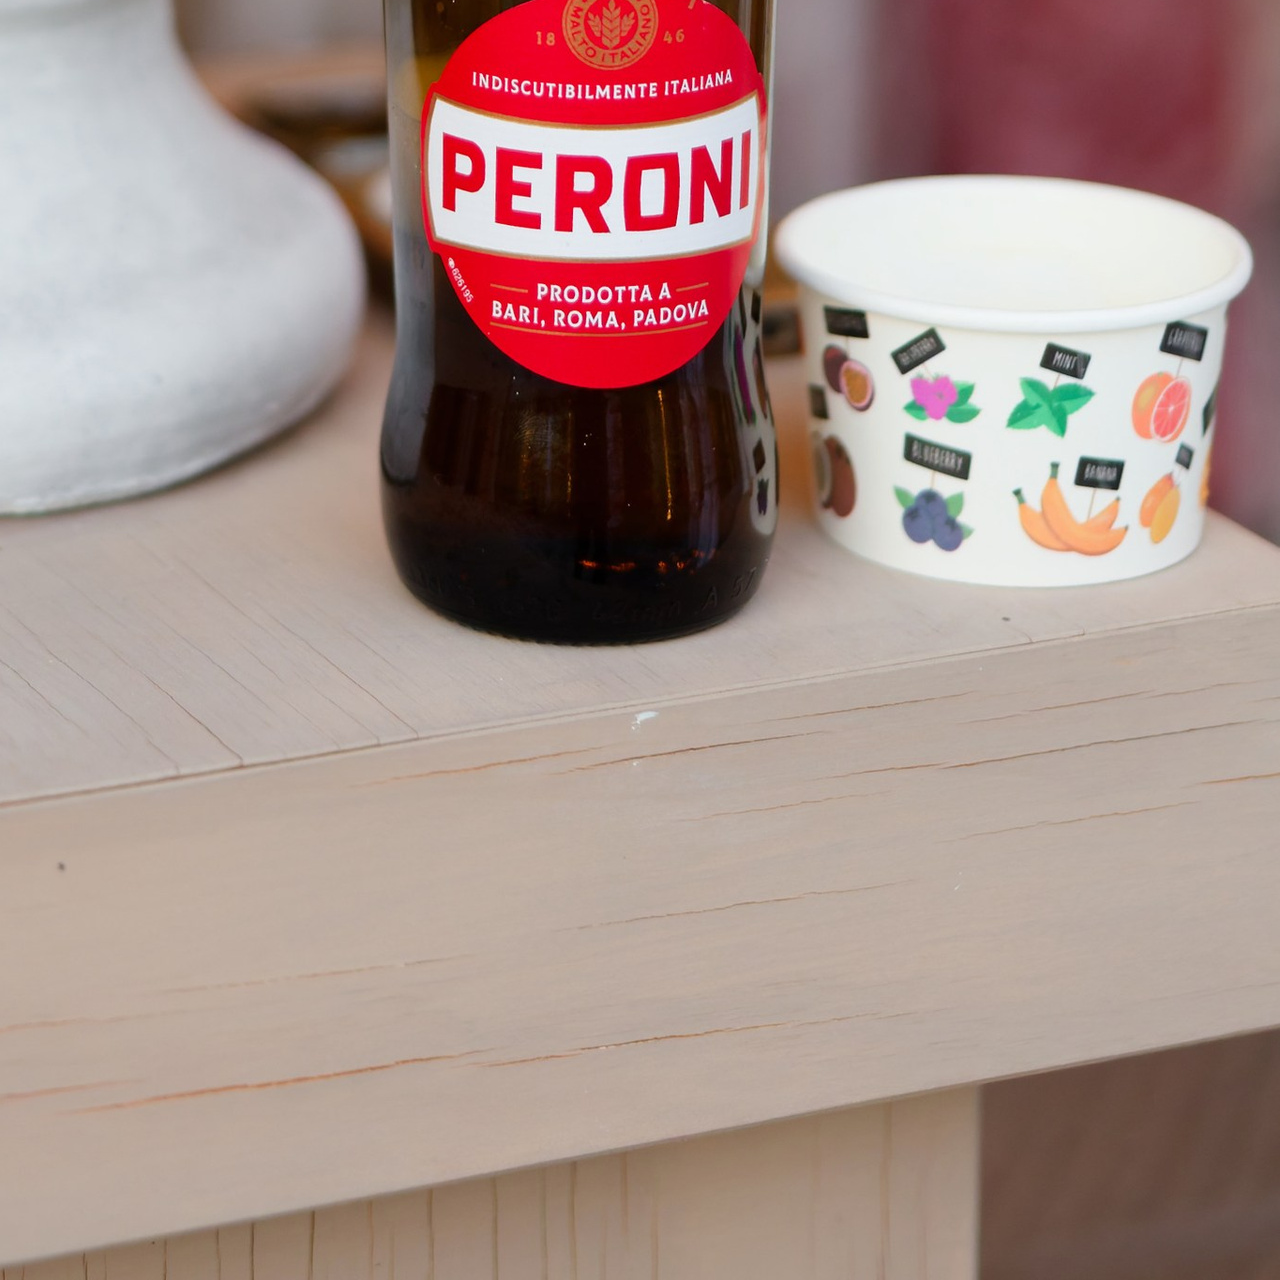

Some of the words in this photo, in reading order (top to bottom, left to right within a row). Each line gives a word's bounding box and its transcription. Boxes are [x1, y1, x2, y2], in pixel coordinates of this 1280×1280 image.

[536, 30, 556, 47] 18
[663, 29, 685, 44] 46
[570, 5, 597, 59] MALTO
[601, 4, 653, 64] ITALIANO
[472, 71, 658, 100] INDISCUTIBILMENTE
[664, 69, 733, 96] ITALIANA
[441, 129, 752, 234] PERONI
[536, 283, 653, 305] PRODOTTA
[658, 282, 672, 300] A
[491, 299, 546, 327] BARI,
[553, 309, 626, 330] ROMA,
[632, 299, 709, 327] PADOVA
[1052, 350, 1078, 370] MINT
